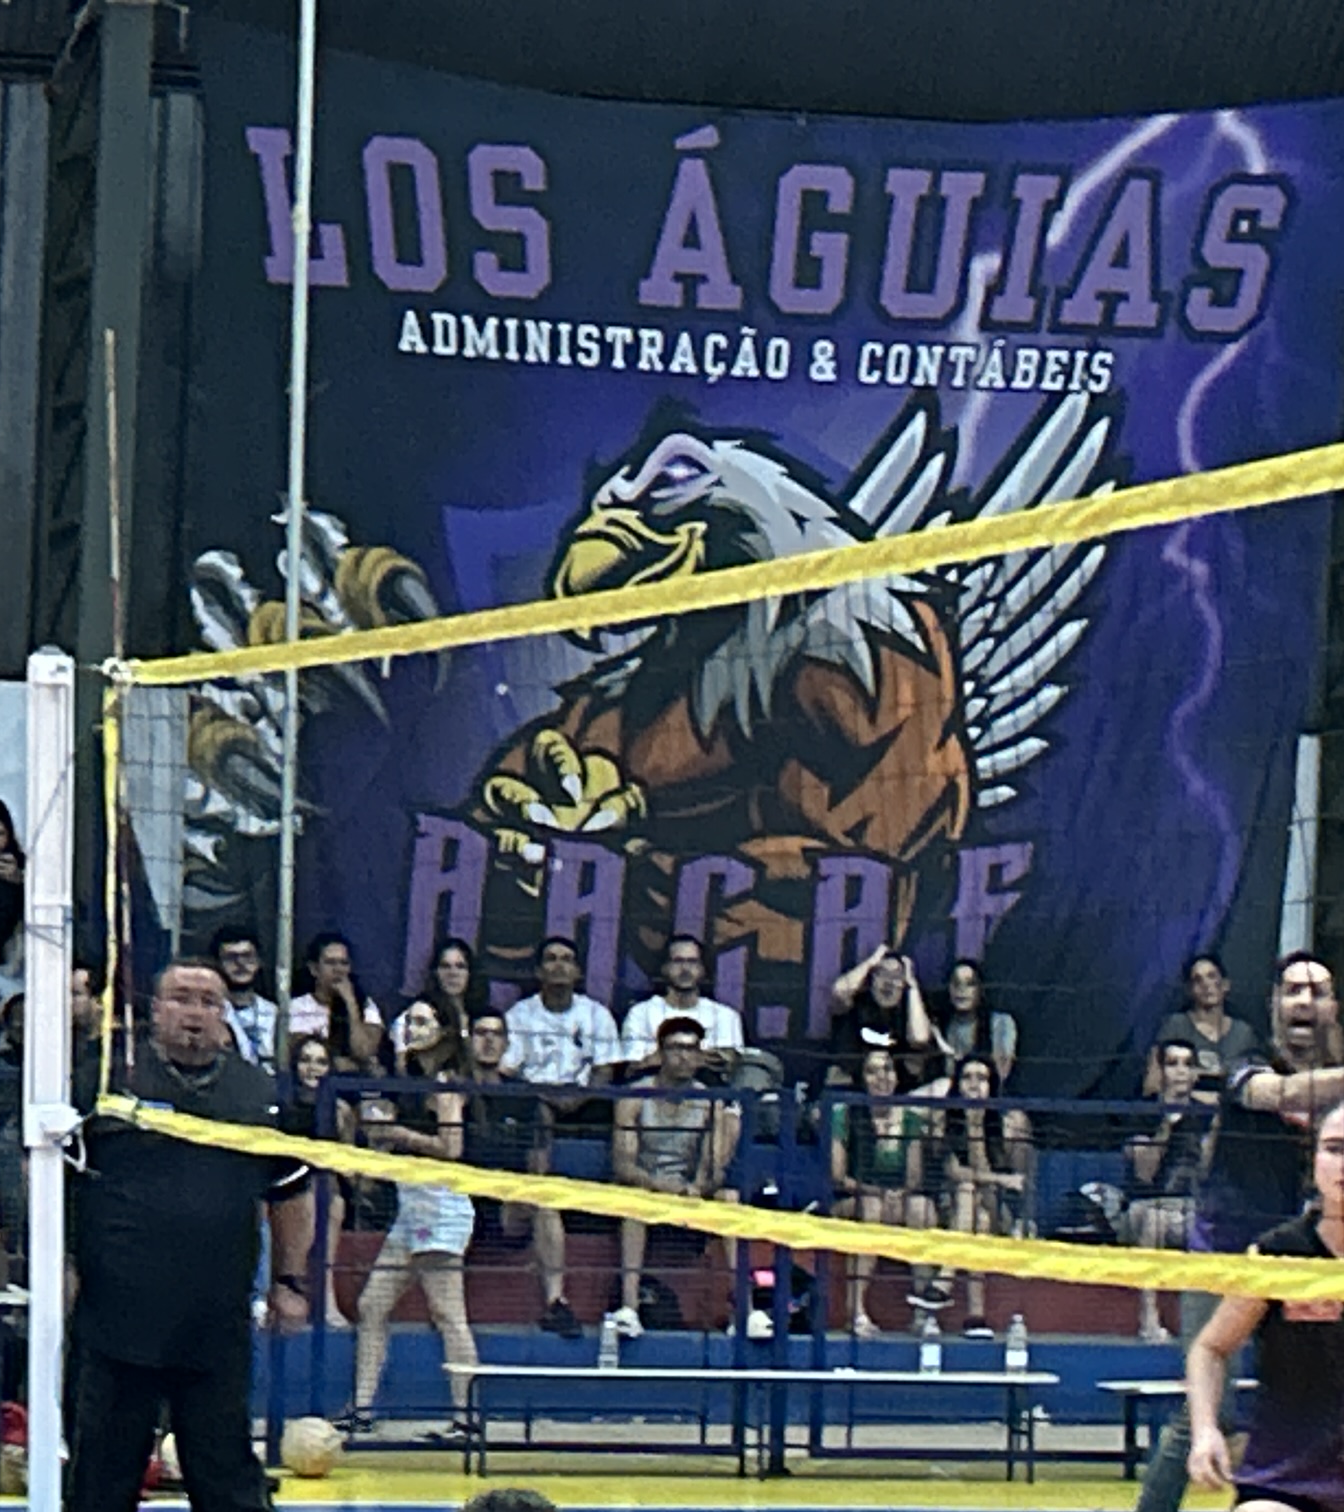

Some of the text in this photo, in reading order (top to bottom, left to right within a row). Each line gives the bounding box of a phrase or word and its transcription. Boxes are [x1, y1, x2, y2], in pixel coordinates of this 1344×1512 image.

[244, 124, 1289, 333] LOS ÁGUIAS
[397, 309, 1114, 393] ADMINISTRAÇÃO & CONTÁBEIS
